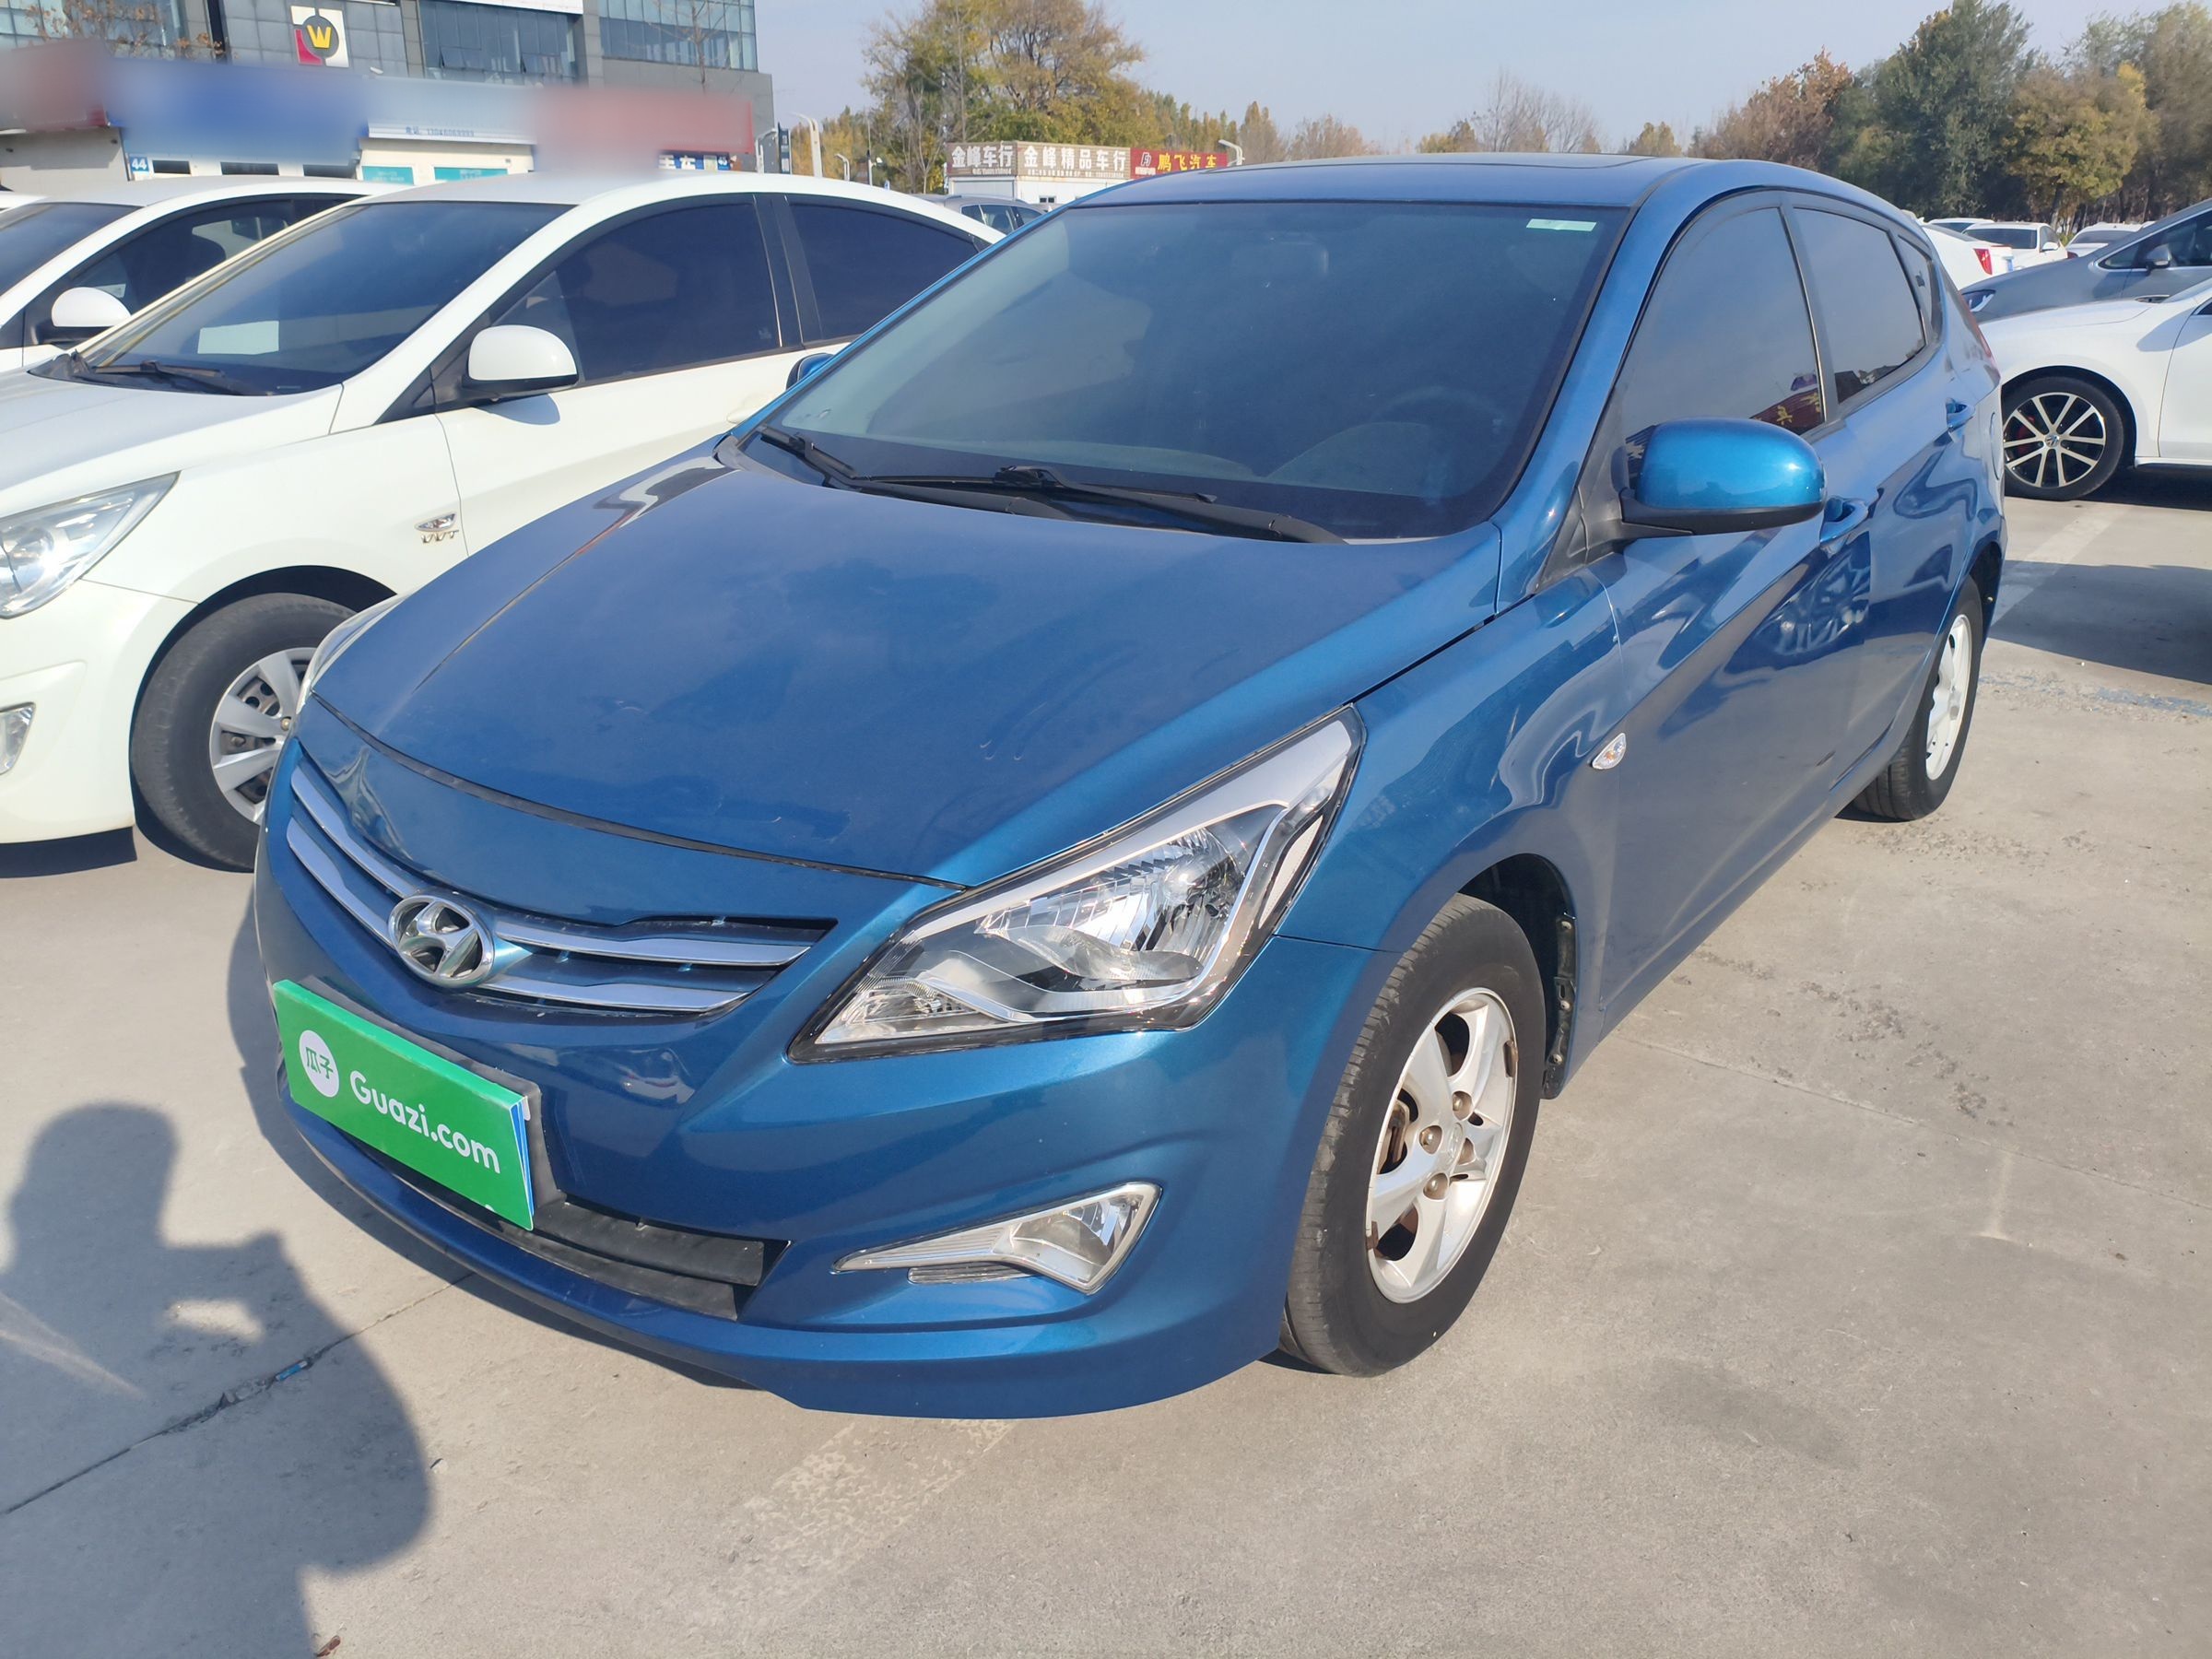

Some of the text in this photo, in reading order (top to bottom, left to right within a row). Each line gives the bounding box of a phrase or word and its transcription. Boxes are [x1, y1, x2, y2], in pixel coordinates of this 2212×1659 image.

[132, 158, 147, 170] 44
[951, 145, 1013, 168] 金峰车行
[1024, 146, 1127, 171] 金峰精品车行
[1158, 152, 1217, 171] 鹏飞汽车
[421, 530, 459, 543] VVT
[306, 1046, 333, 1079] 瓜子
[350, 1070, 500, 1173] Guazi.com
